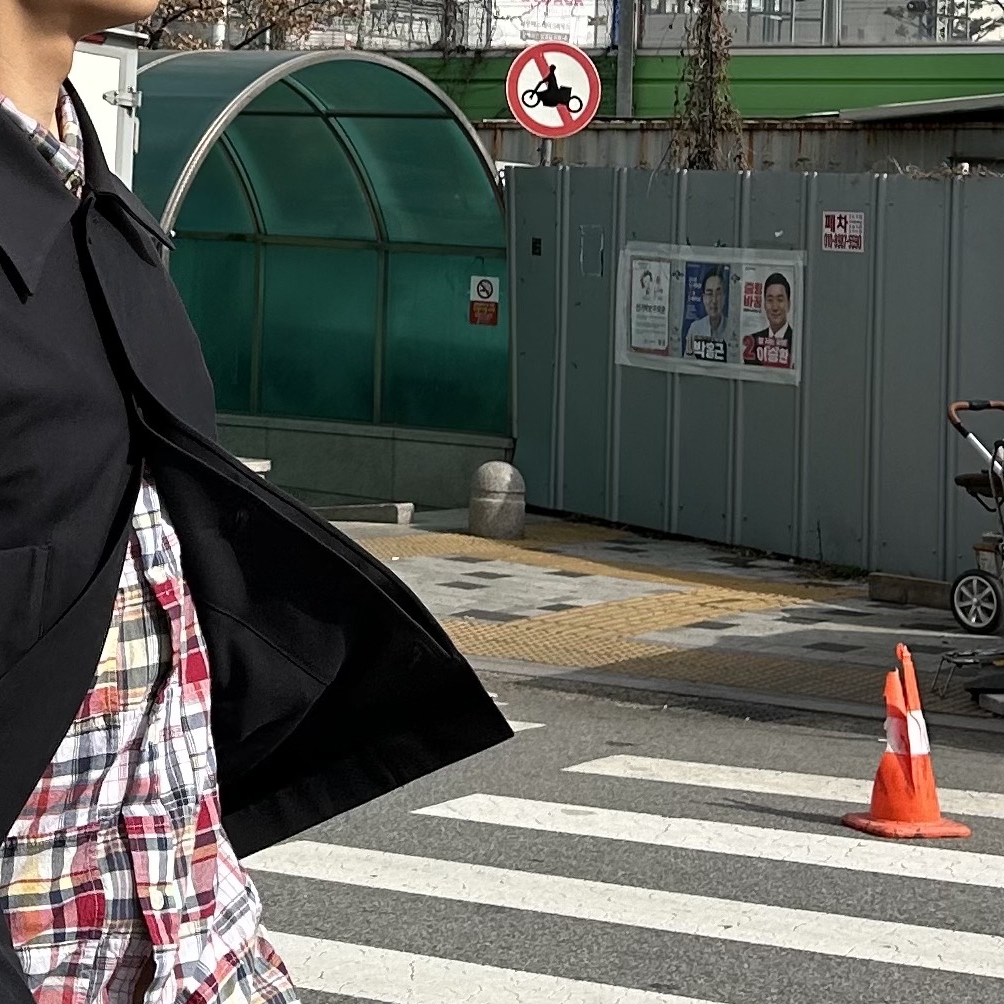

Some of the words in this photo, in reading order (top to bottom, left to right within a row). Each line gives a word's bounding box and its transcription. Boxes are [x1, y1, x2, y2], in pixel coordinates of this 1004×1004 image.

[693, 340, 725, 361] 박홍근
[742, 335, 756, 361] 2
[756, 345, 789, 365] 이승환
